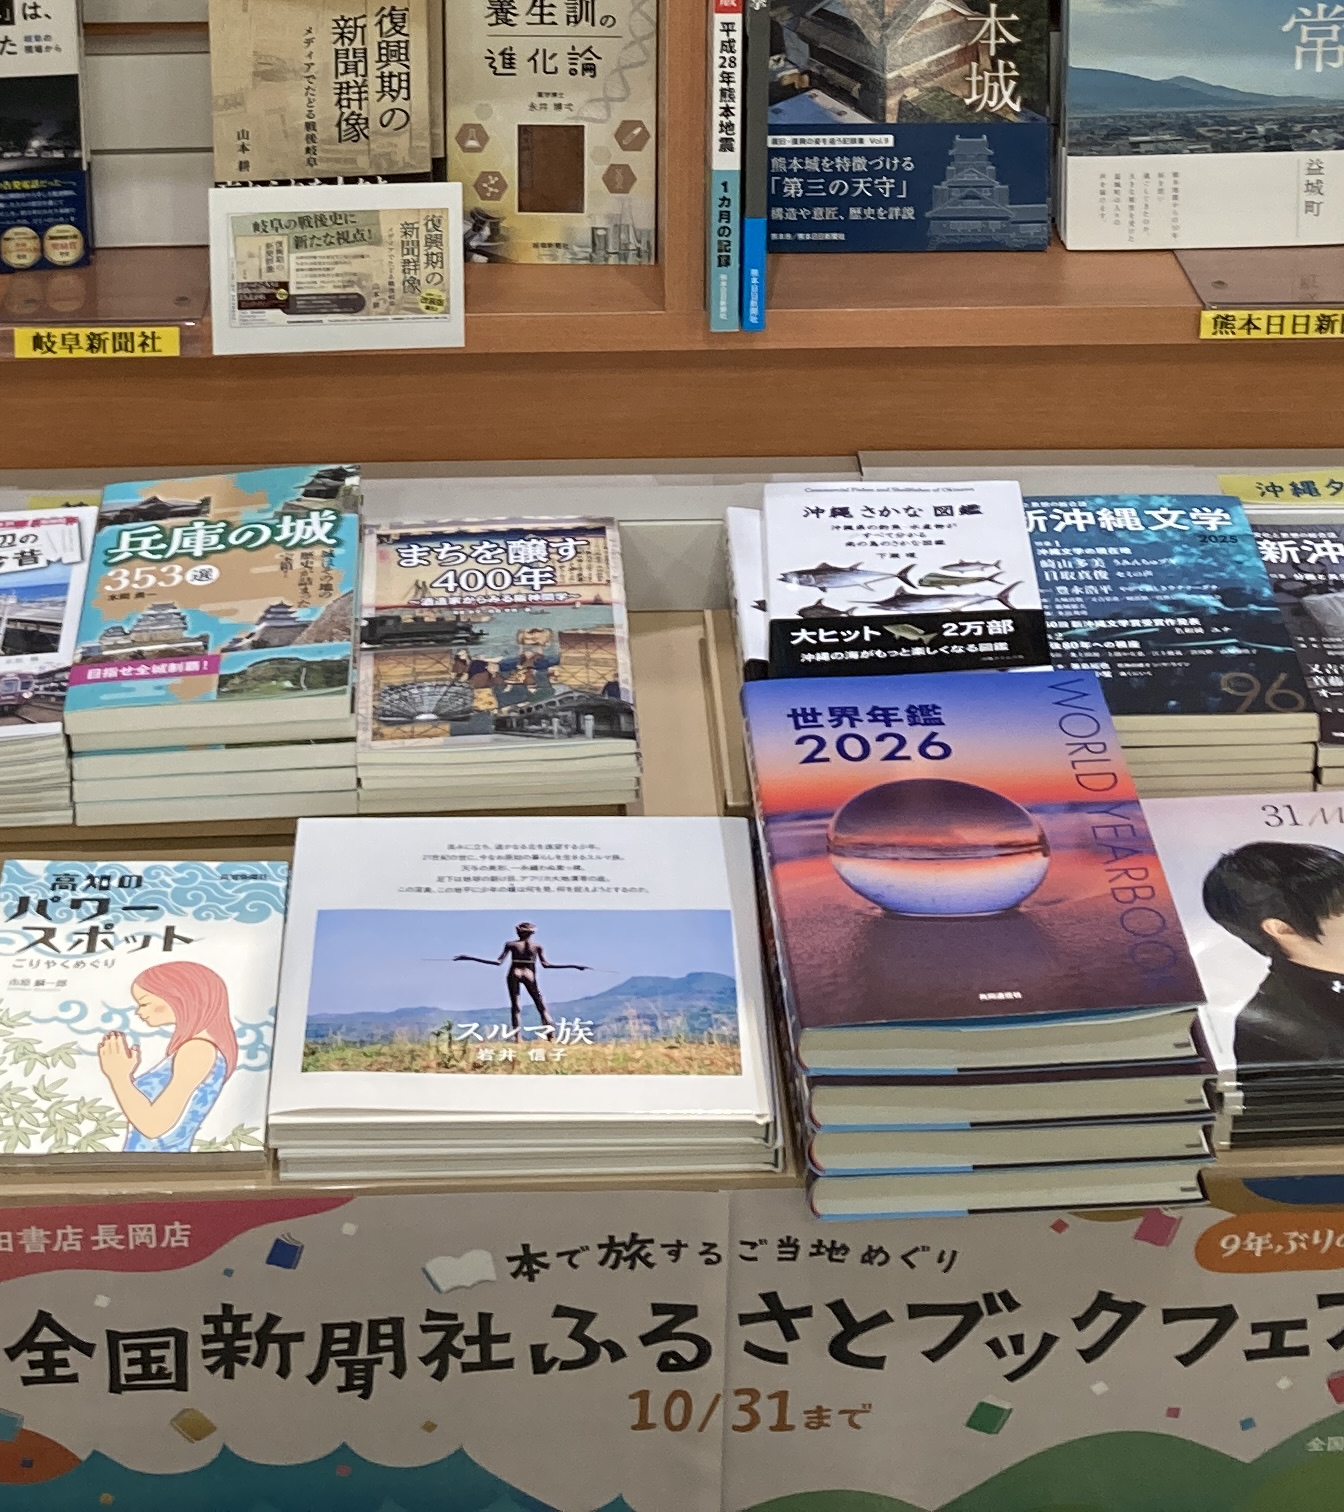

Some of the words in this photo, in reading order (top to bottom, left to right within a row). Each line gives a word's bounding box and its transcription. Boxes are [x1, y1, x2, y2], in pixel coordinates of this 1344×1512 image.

[374, 4, 412, 133] 復興期の
[484, 46, 603, 79] 進化論
[331, 14, 369, 144] 新聞群像
[717, 21, 737, 153] 平成28年熊本地震
[770, 155, 916, 173] 熊本城を特徴づける
[770, 175, 908, 199] 「第三の天守」
[1303, 156, 1325, 218] 益城町
[716, 180, 733, 269] 1カ月の記録
[770, 206, 916, 221] 構造や意匠、歴史を詳説
[422, 214, 445, 288] 復興期の
[31, 330, 162, 355] 岐阜新聞社
[104, 510, 340, 565] 兵庫の城
[396, 537, 588, 569] まちを醸す
[430, 566, 557, 593] 400年
[790, 625, 881, 644] 大ヒット
[942, 620, 1015, 636] 2万部
[800, 641, 1009, 662] 沖縄の海がもっと楽しくなる図鑑
[786, 703, 947, 730] 世界年鑑
[794, 731, 953, 765] 2026
[1260, 803, 1299, 828] 31
[1047, 675, 1120, 795] WORLD
[1086, 801, 1181, 988] YEARBOOK
[51, 873, 144, 892] 高知の
[13, 897, 161, 923] パワー
[32, 924, 197, 955] スポット
[455, 1017, 595, 1047] スルマ族
[476, 1048, 515, 1062] 岩井
[528, 1048, 568, 1062] 信子
[504, 1231, 963, 1283] 本で旅するご当地めぐり
[627, 1387, 874, 1436] 10/31まで
